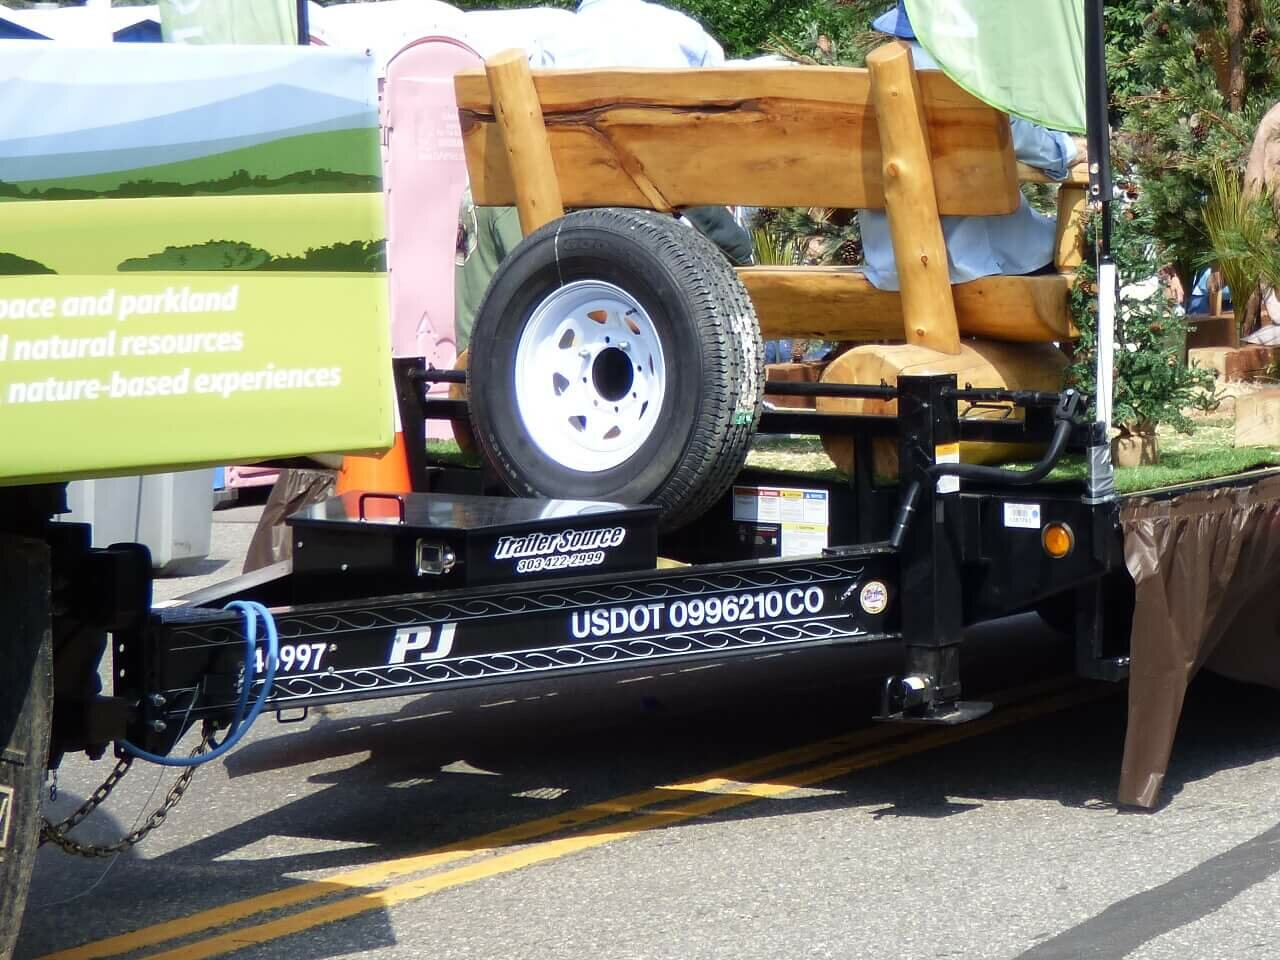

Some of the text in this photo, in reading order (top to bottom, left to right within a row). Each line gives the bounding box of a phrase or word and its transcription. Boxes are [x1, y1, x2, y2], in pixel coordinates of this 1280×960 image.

[61, 288, 115, 318] and
[117, 285, 240, 321] parkland
[13, 330, 116, 361] natural
[120, 330, 244, 356] resources
[8, 363, 343, 404] nature-based experiences
[572, 603, 665, 638] USDOT
[669, 591, 783, 628] 0996210
[785, 586, 824, 615] CO
[388, 623, 457, 664] PJ
